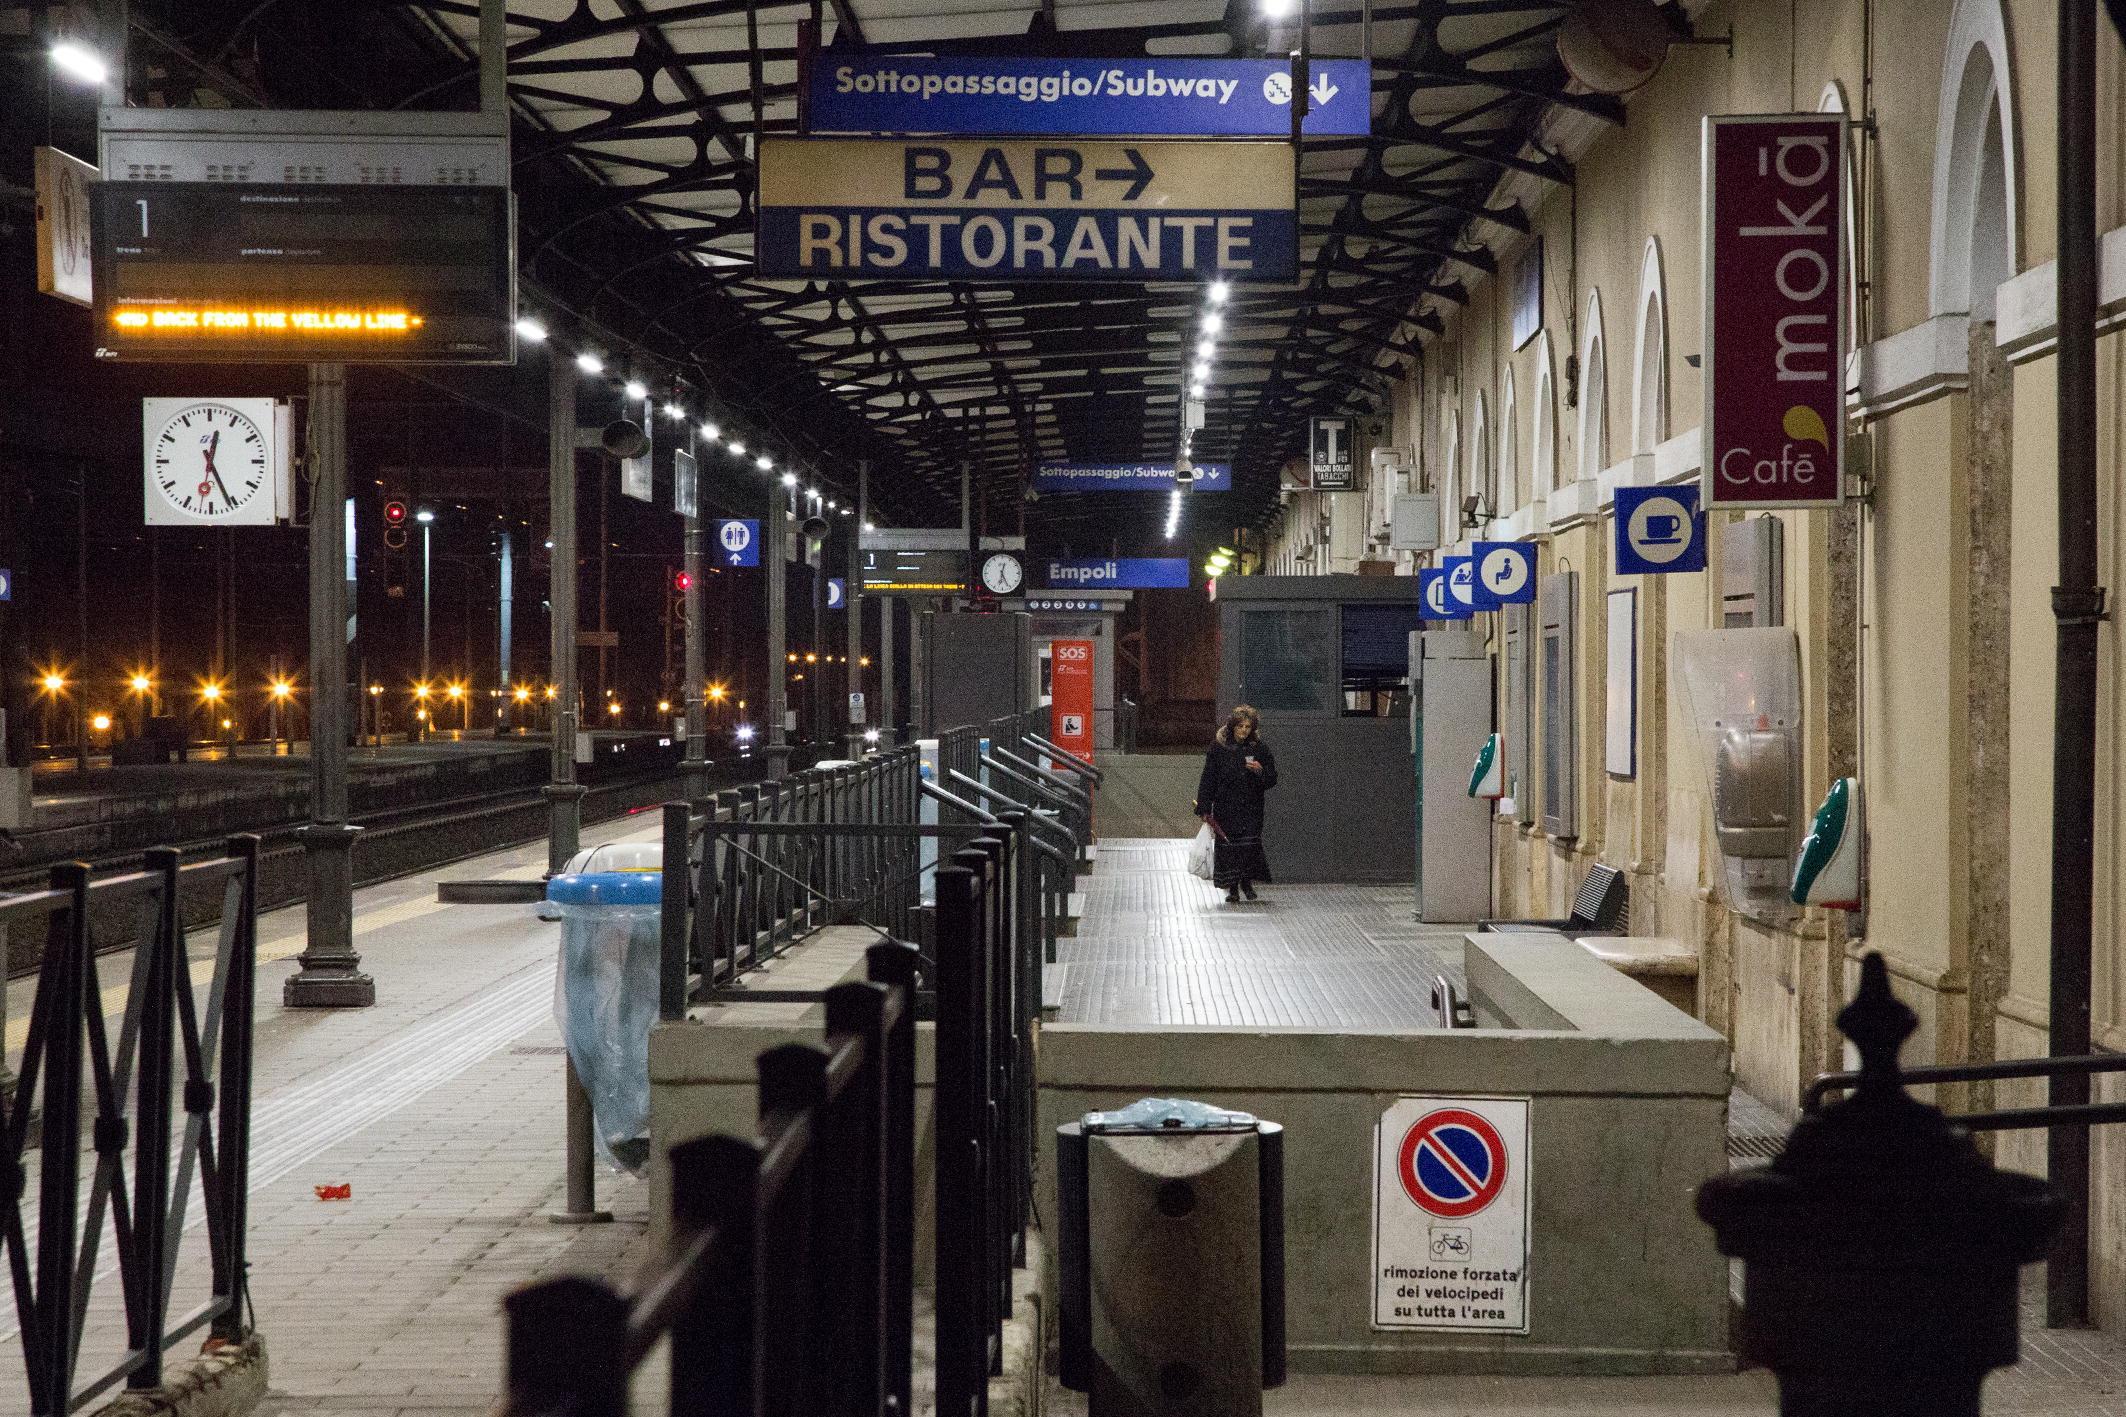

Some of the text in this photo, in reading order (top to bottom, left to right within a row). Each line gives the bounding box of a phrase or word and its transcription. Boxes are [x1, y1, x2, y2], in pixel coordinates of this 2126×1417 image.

[835, 66, 1239, 104] Sottopassaggio/Subway
[903, 146, 1083, 200] BAR
[136, 200, 148, 238] 1
[801, 214, 1254, 270] RISTORANTE
[152, 311, 199, 327] BACK
[253, 312, 287, 328] THE
[291, 313, 361, 329] YELLOW
[1319, 421, 1346, 465] T
[1039, 466, 1176, 479] Sottopassaggio/Subwa
[1050, 562, 1117, 583] Empoli
[1059, 646, 1086, 659] SOS
[1384, 1265, 1517, 1282] rimozione forzata
[1397, 1285, 1504, 1302] dei velocipedi
[1394, 1305, 1505, 1319] su tutta l'area
